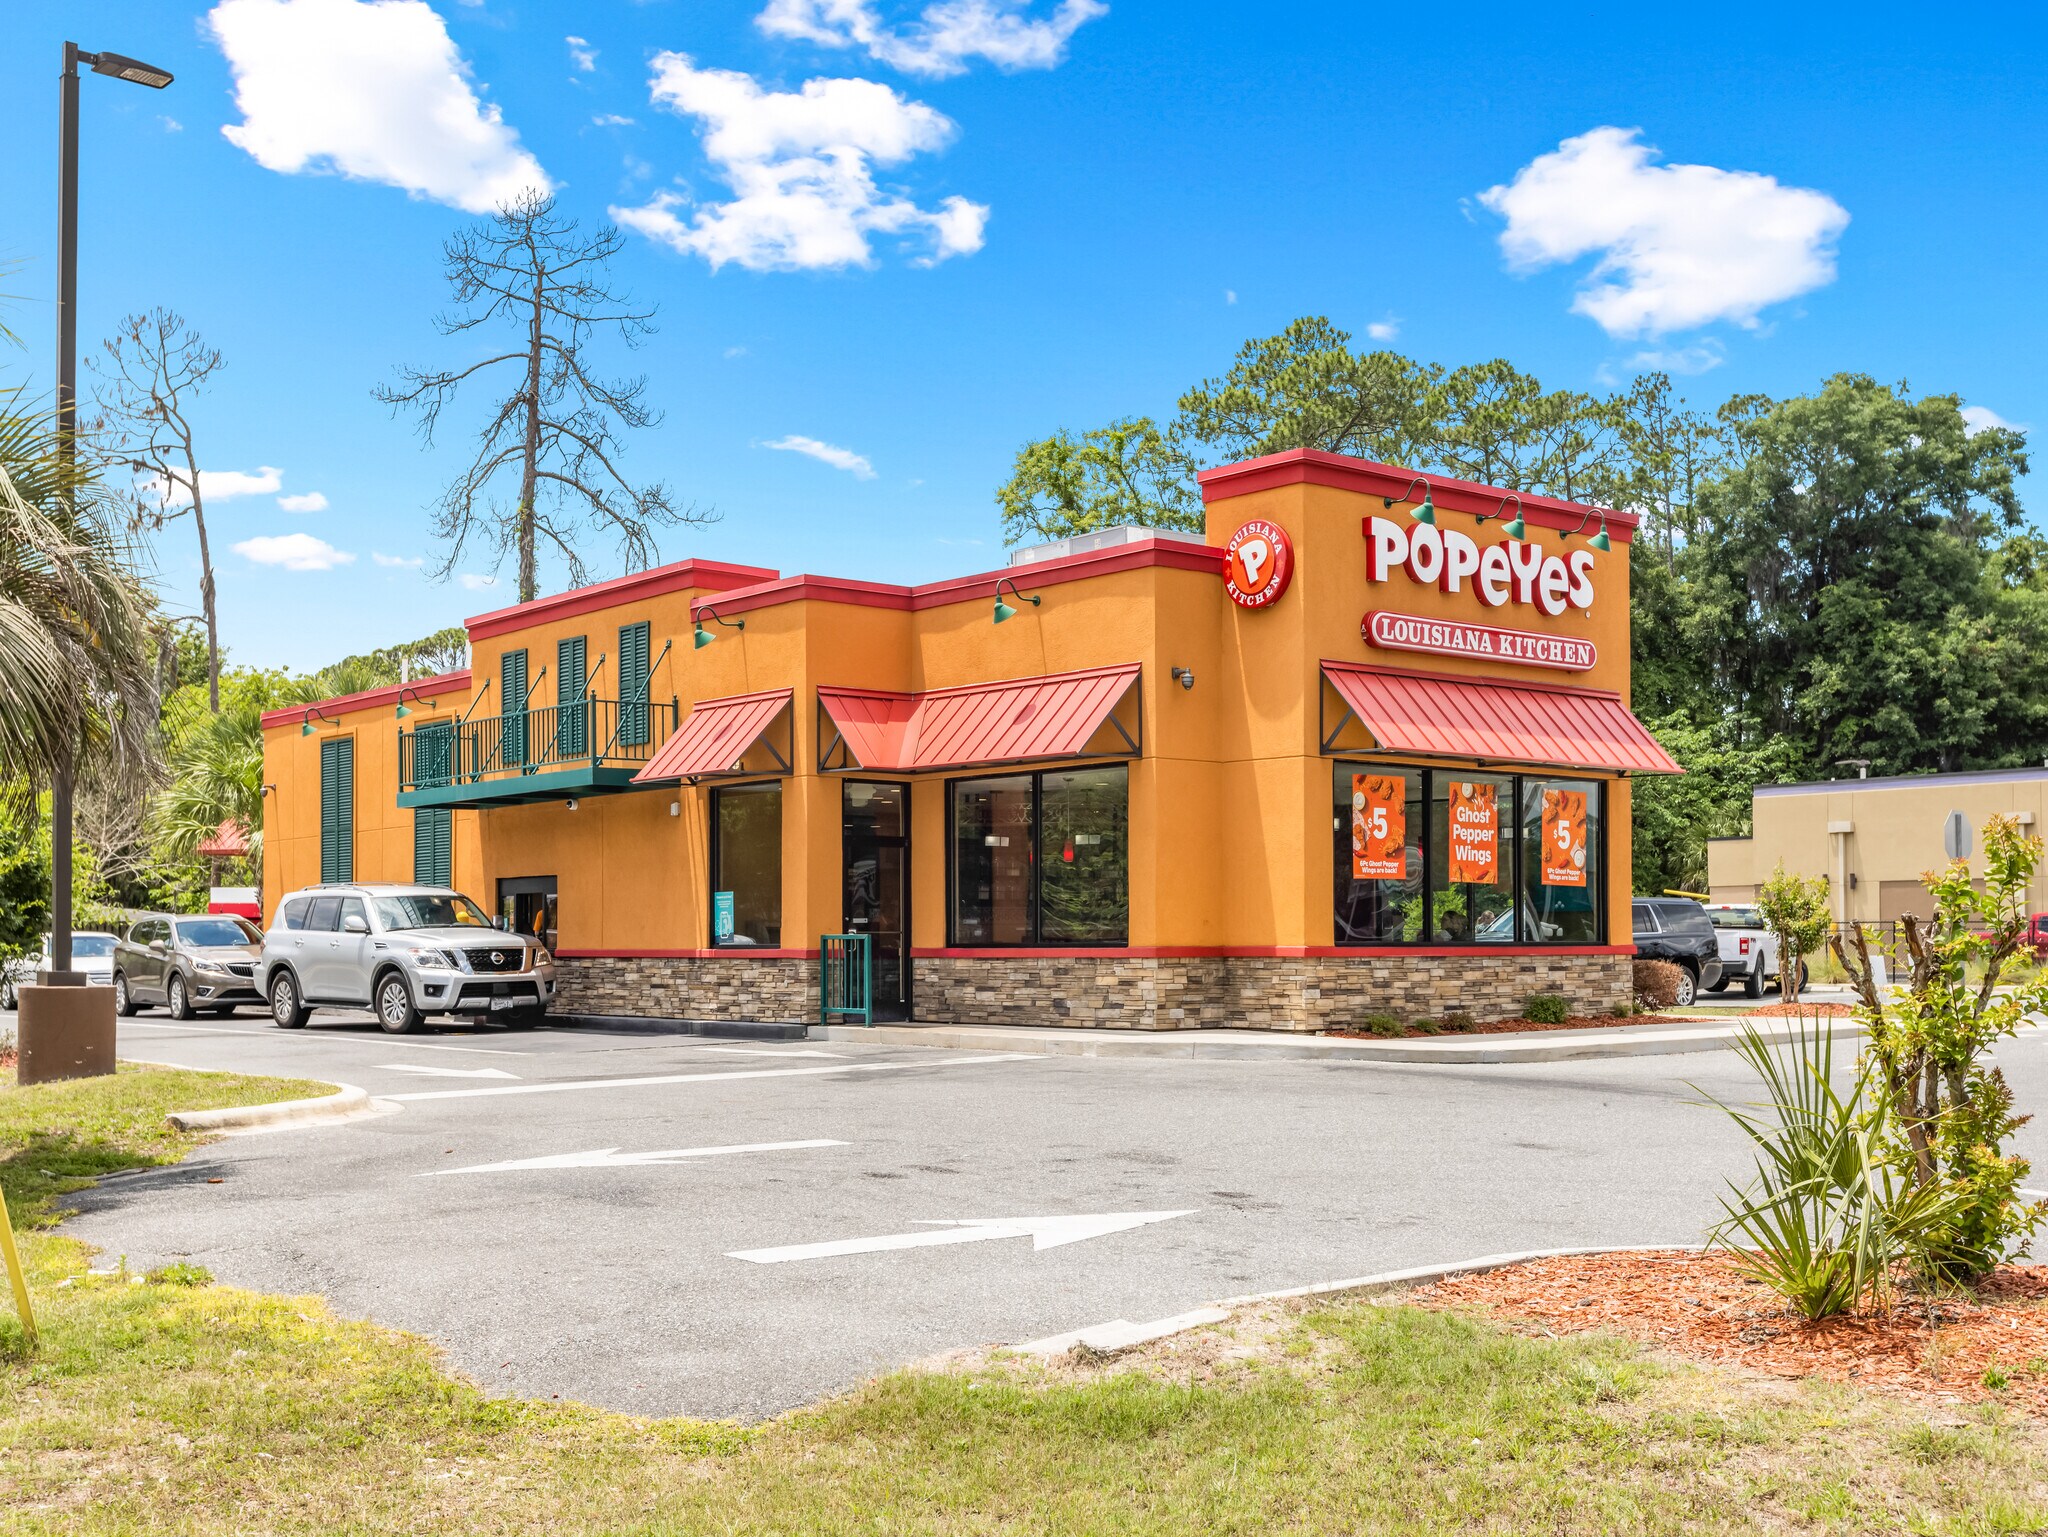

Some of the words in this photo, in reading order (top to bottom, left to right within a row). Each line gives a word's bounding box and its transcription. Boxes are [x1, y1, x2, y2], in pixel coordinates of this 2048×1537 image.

[1225, 523, 1282, 562] LOUISIANA
[1238, 540, 1268, 584] P
[1227, 575, 1280, 606] KITCHEN
[1381, 617, 1493, 652] LOUISIANA
[1499, 635, 1591, 664] KITCHEN
[1367, 807, 1388, 840] $5
[1456, 806, 1490, 823] Ghost
[1453, 824, 1494, 844] Pepper
[1553, 820, 1571, 849] $5
[1383, 860, 1399, 868] Pepper
[1455, 845, 1492, 865] Wings
